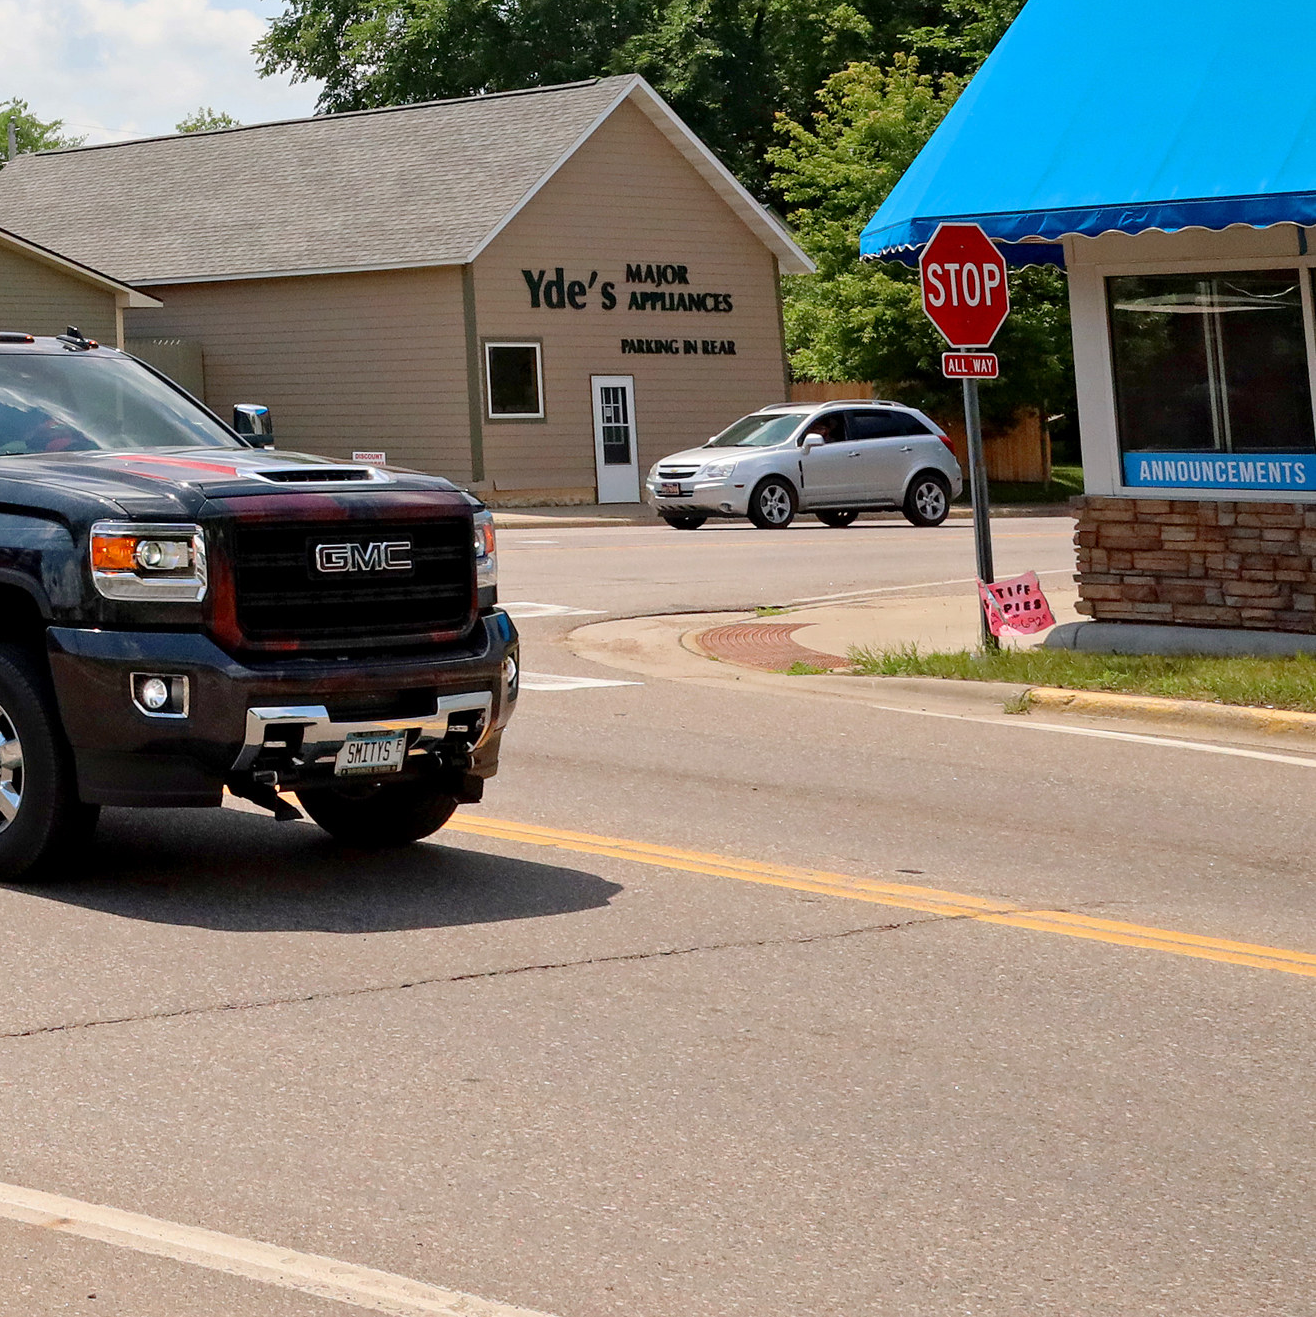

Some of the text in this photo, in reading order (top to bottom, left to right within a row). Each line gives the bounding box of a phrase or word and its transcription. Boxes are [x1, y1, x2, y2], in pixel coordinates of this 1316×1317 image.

[625, 263, 690, 288] MAJOR
[926, 262, 1001, 307] STOP
[521, 267, 617, 311] Yde's
[627, 291, 734, 313] APPLIANCES
[620, 338, 737, 356] PARKING IN REAR
[947, 357, 994, 374] ALL WAY
[1139, 460, 1306, 484] ANNOUNCEMENTS
[317, 541, 413, 572] GMC
